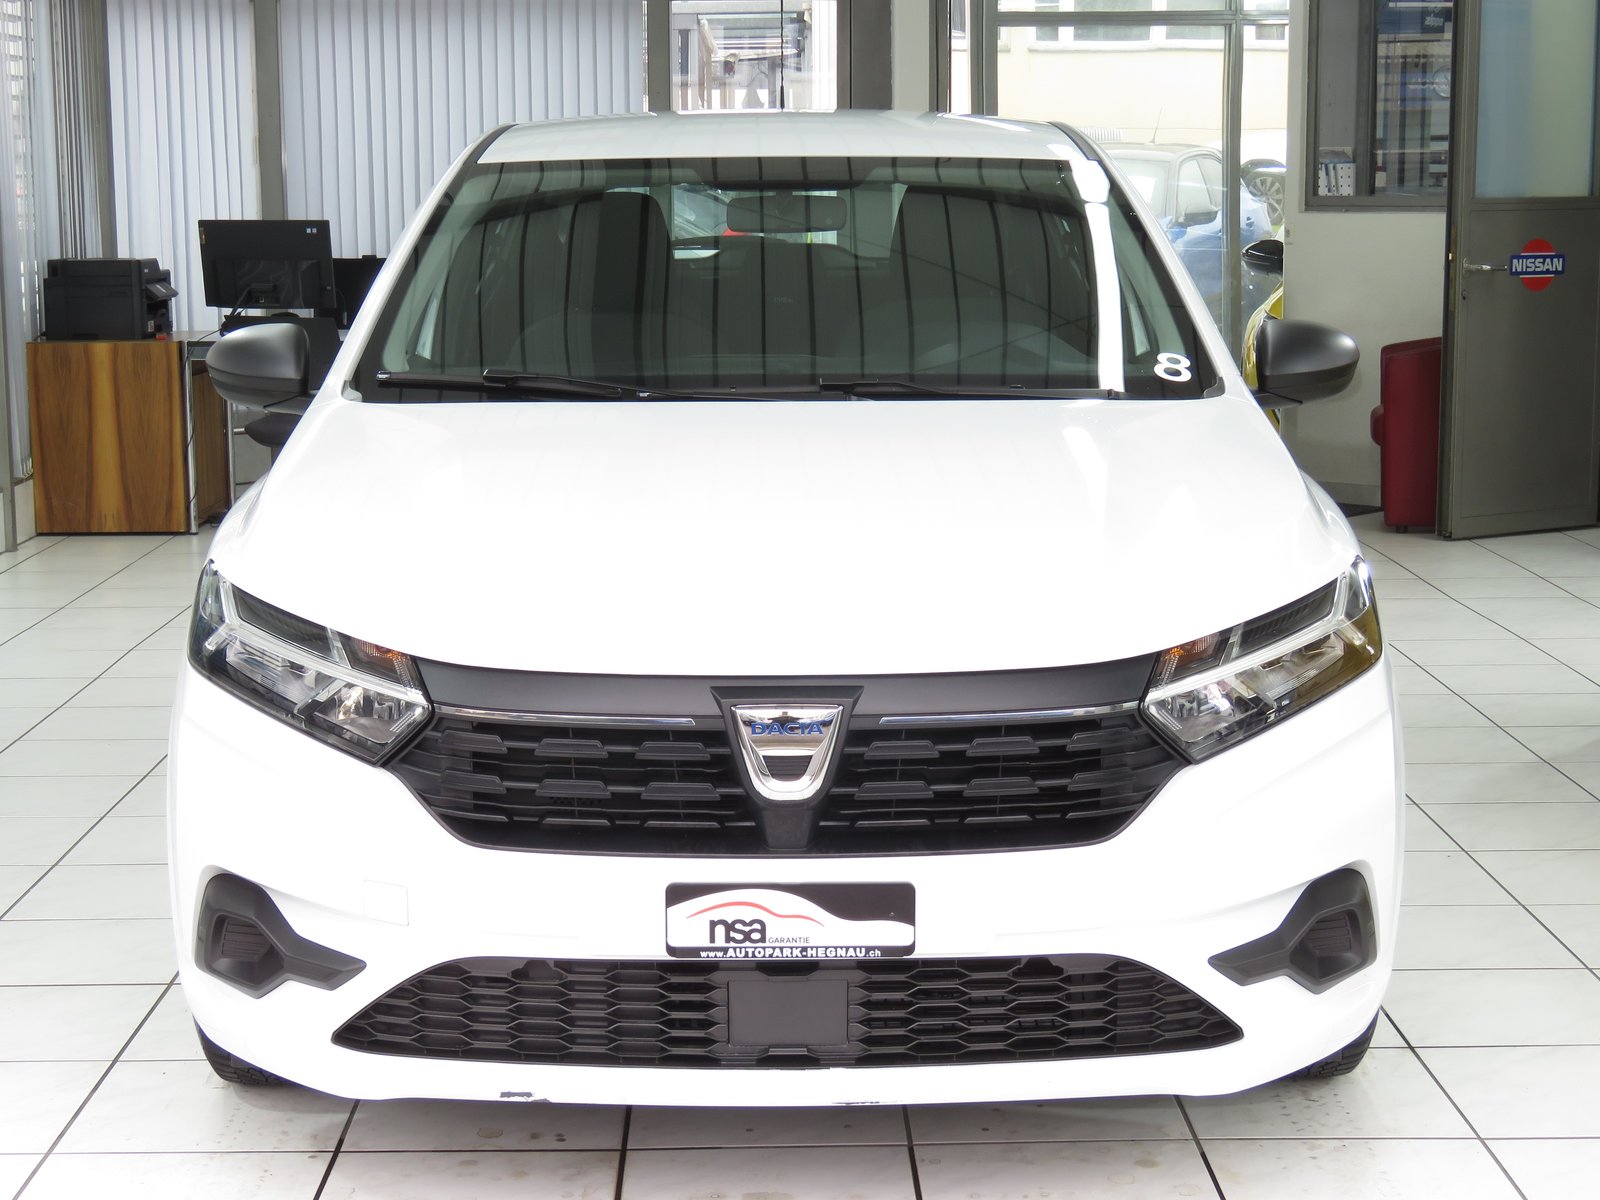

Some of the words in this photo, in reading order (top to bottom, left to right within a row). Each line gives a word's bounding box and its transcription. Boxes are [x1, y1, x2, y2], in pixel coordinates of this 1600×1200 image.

[1511, 258, 1563, 272] NISSAN
[1153, 352, 1192, 382] 8
[751, 722, 824, 736] DACIA
[709, 918, 767, 944] nsa
